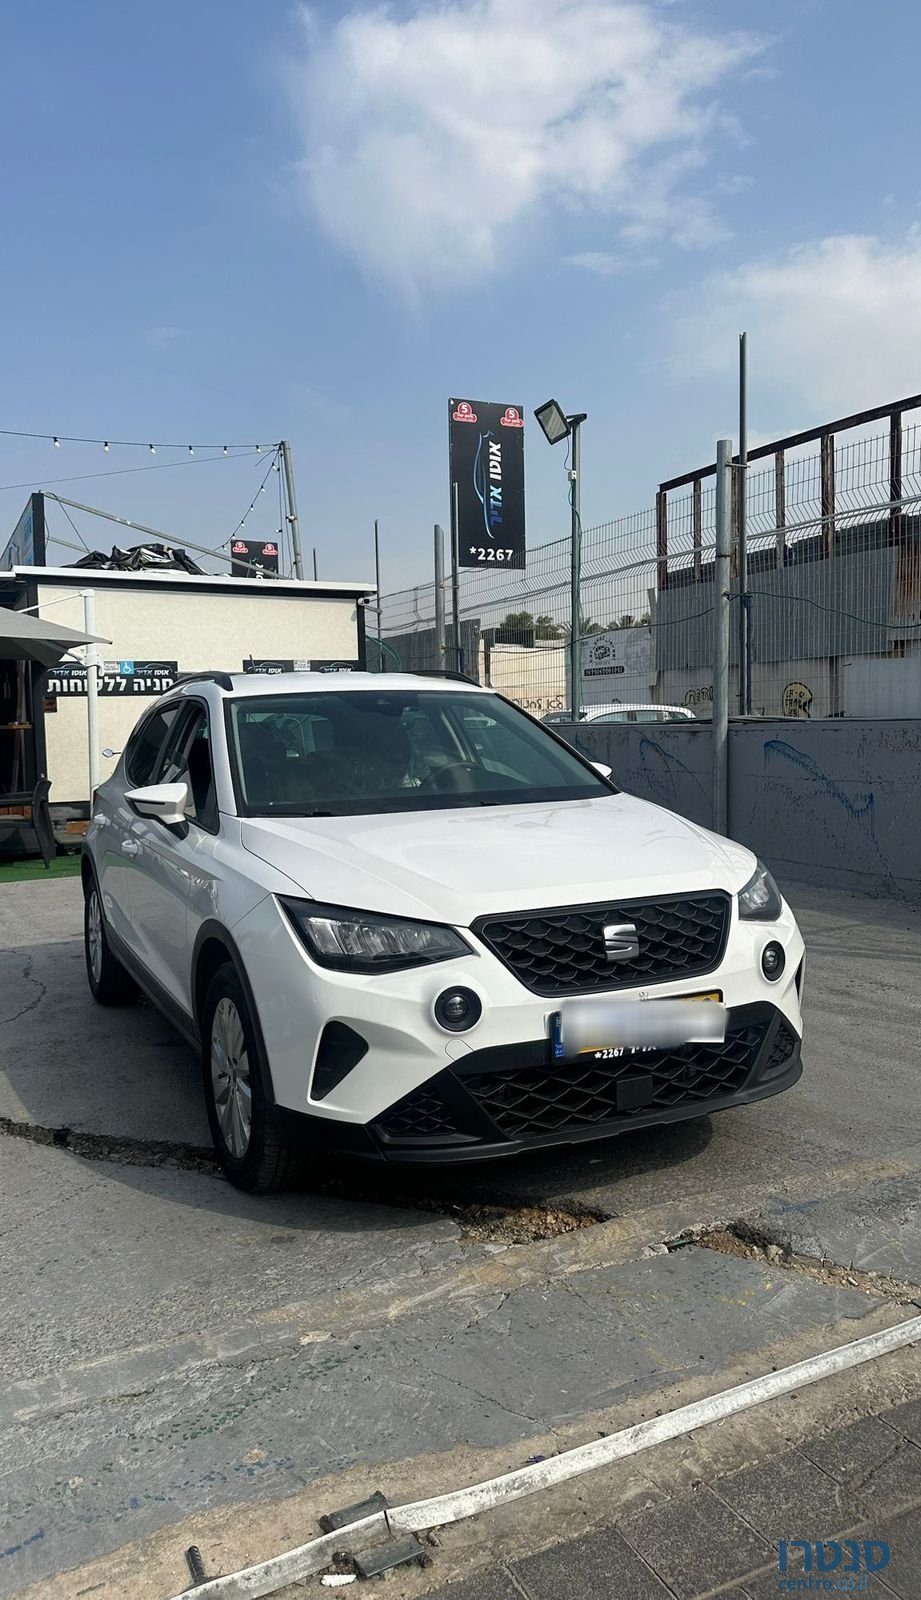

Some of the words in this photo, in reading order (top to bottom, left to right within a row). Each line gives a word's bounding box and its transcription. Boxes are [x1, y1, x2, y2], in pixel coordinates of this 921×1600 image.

[461, 404, 468, 413] 5
[508, 409, 515, 418] 5
[489, 441, 502, 480] אוטו
[489, 485, 502, 527] אדיר
[133, 679, 174, 692] חניה
